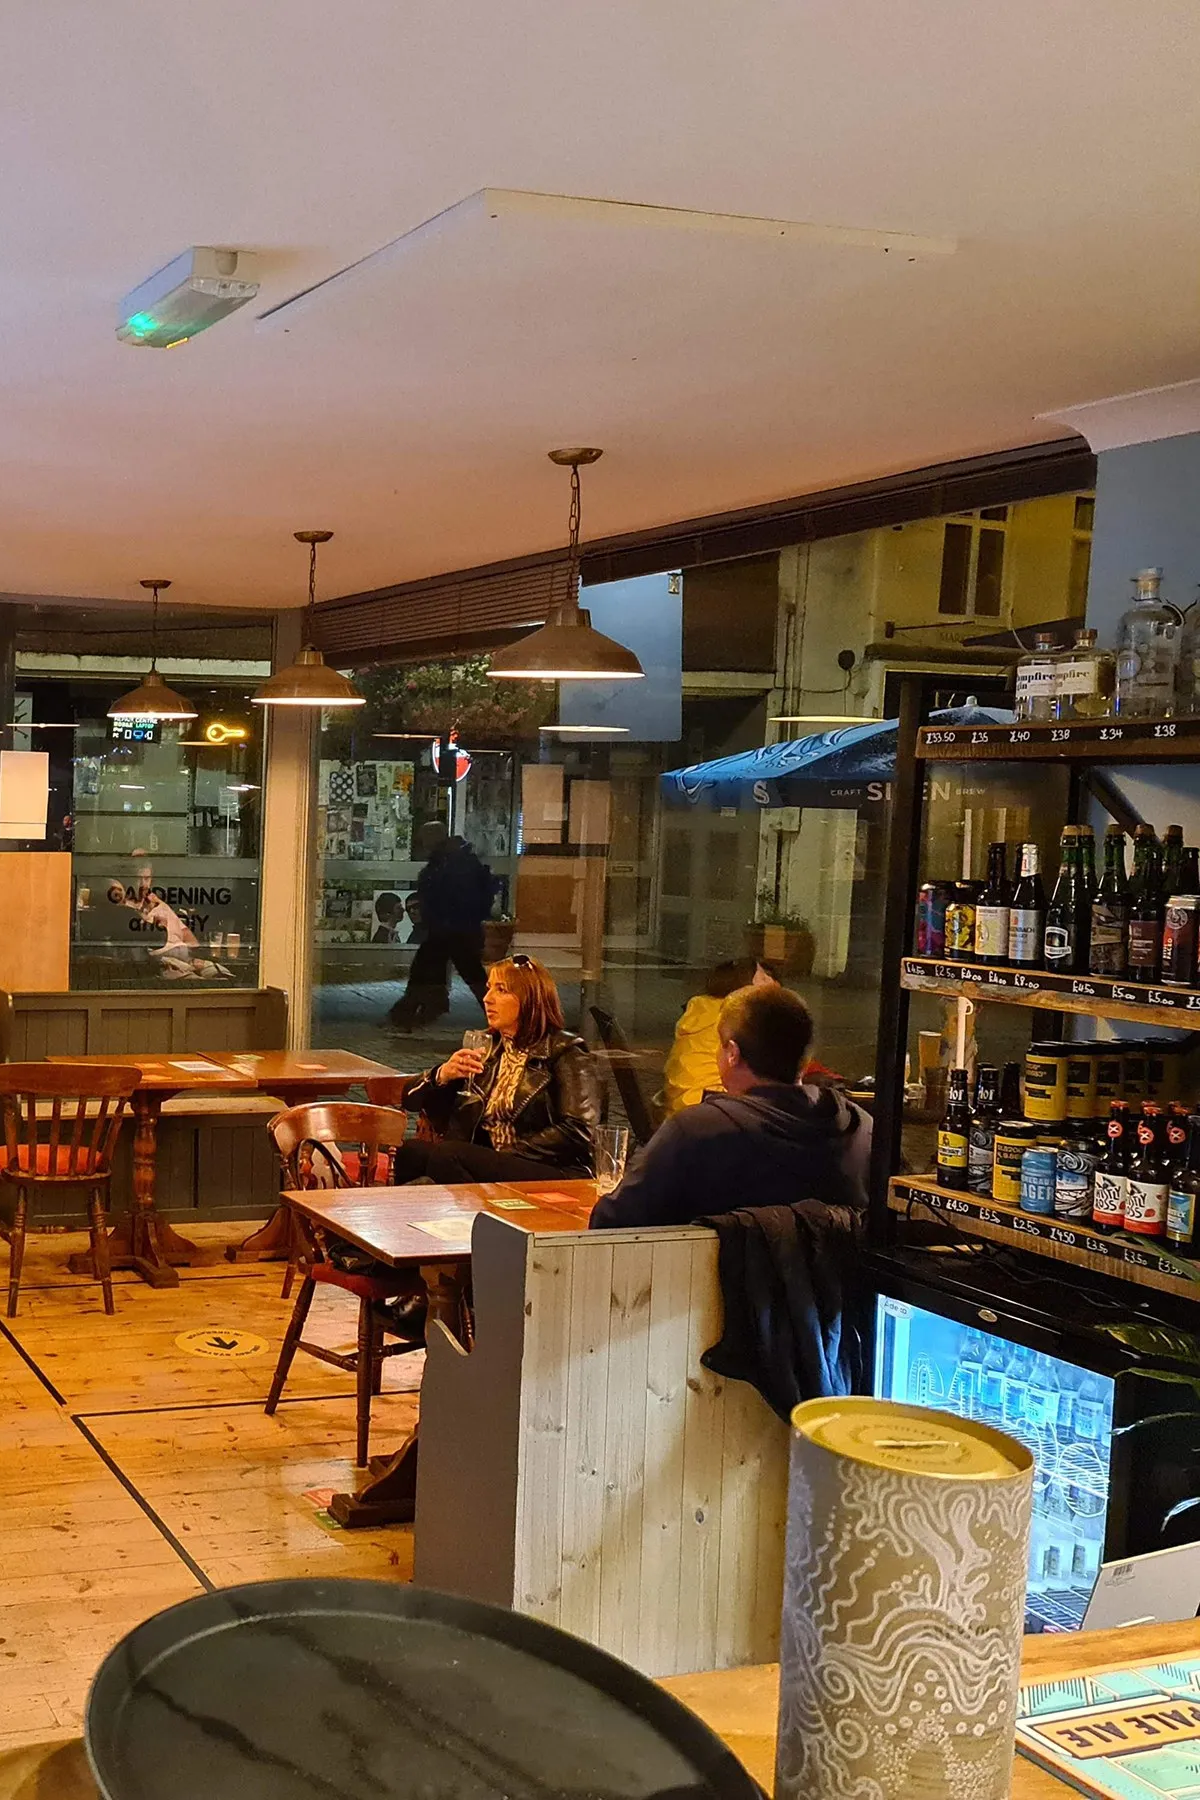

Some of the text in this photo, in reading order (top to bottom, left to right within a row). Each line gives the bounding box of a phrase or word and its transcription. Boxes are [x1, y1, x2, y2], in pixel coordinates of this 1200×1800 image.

[926, 725, 1176, 744] £33.50 £35 £40 £38 £34 £38
[830, 788, 862, 797] CRAFT
[1014, 974, 1040, 989] £8.00
[1056, 1721, 1128, 1749] ALE
